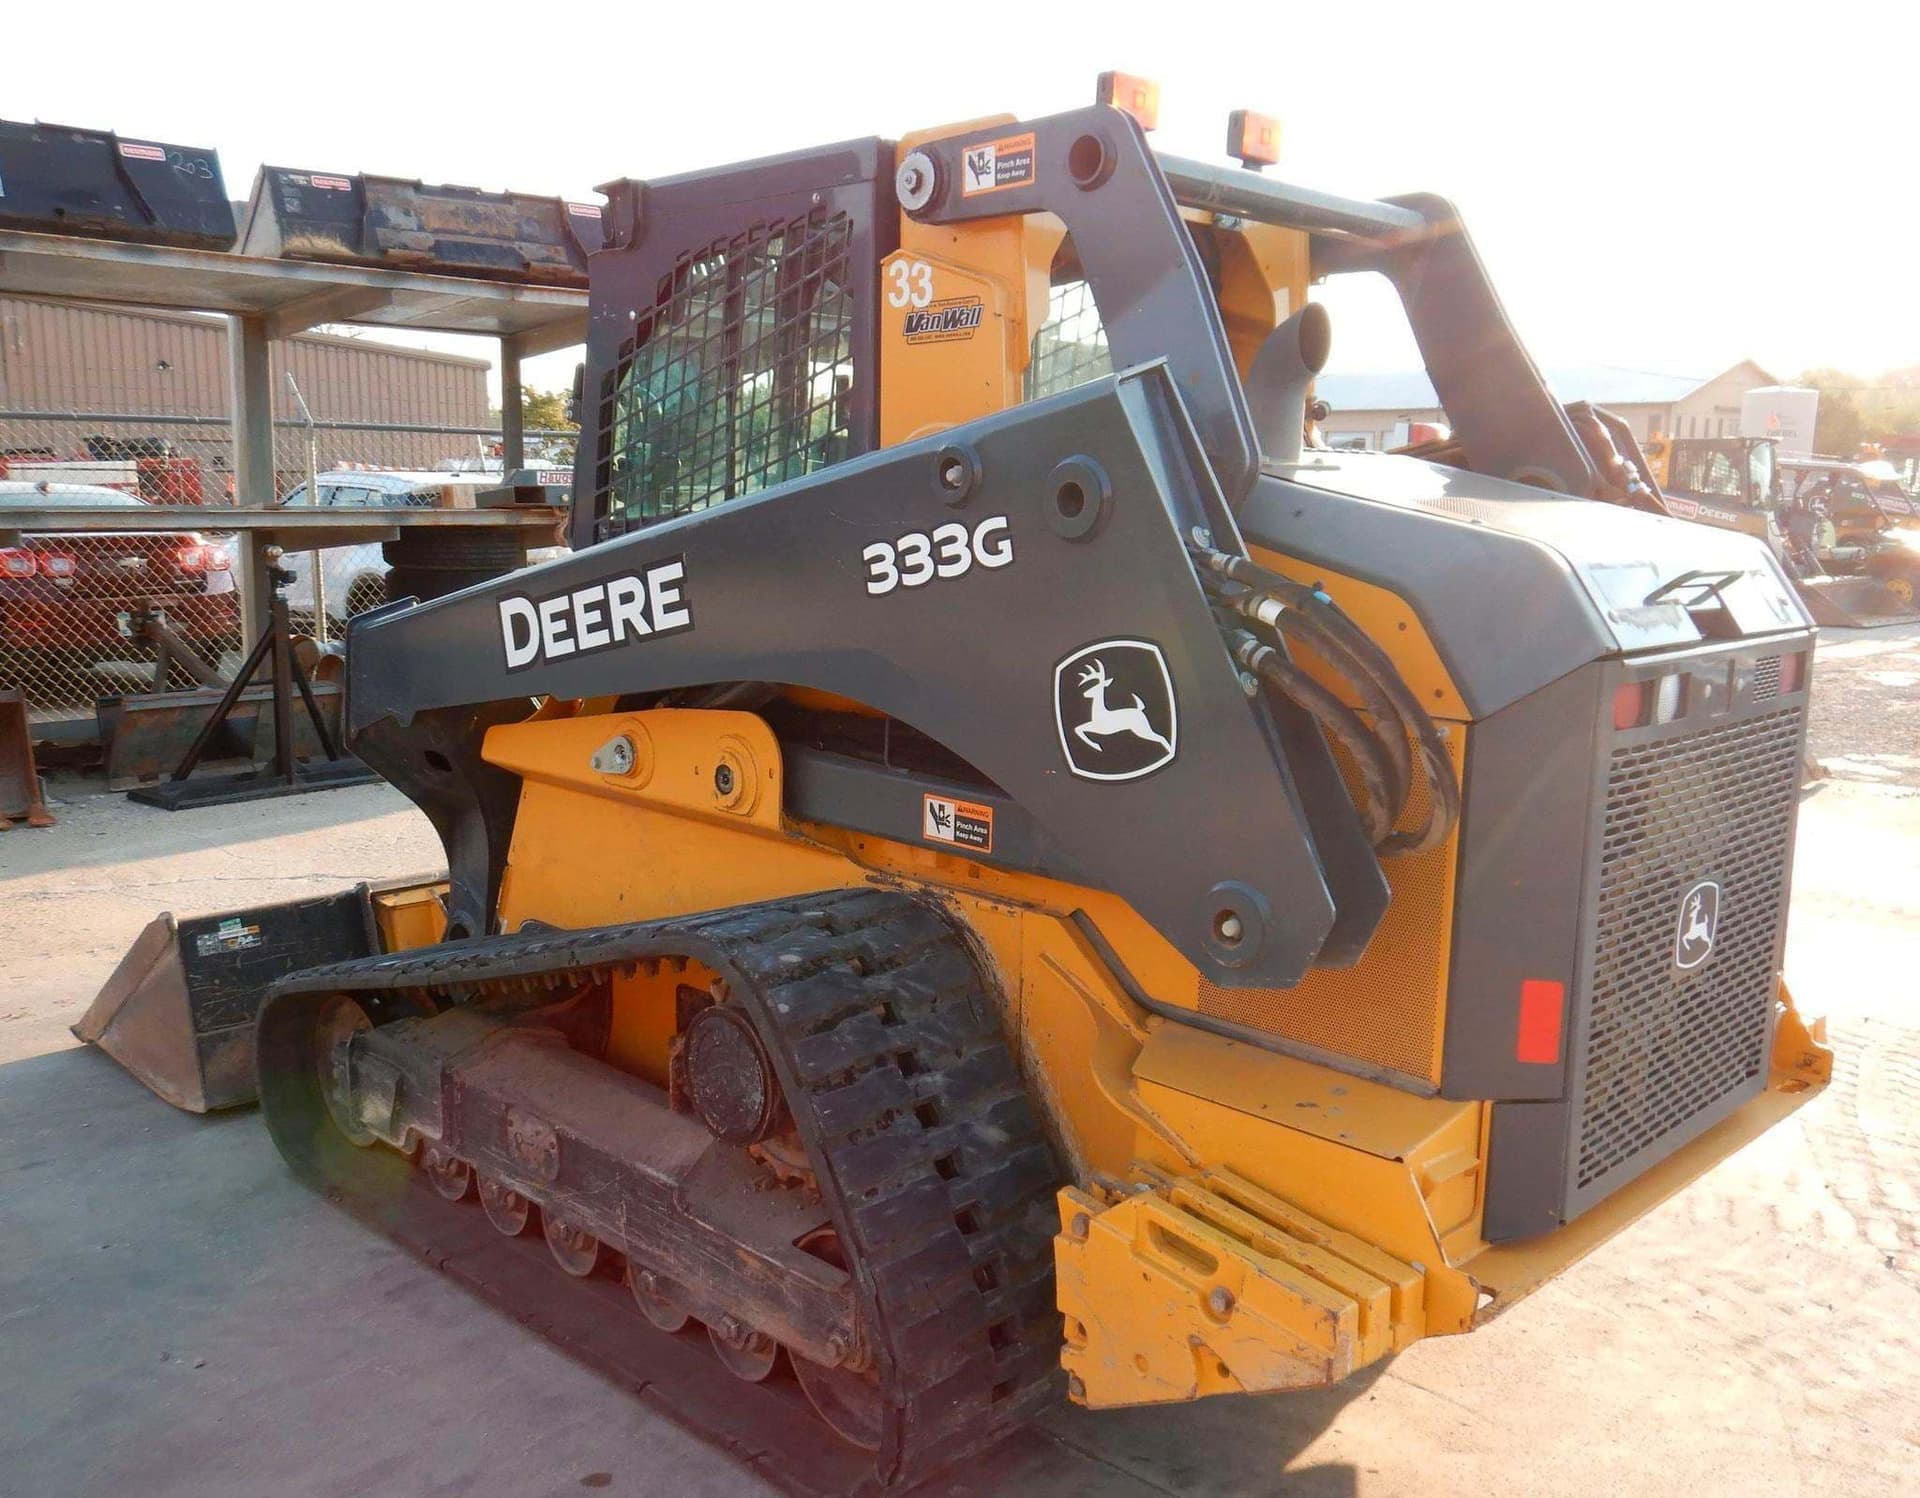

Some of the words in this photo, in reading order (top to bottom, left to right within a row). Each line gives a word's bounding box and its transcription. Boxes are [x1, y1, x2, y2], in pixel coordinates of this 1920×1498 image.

[997, 160, 1015, 170] Pinch
[1016, 157, 1030, 166] Area
[888, 259, 933, 308] 33
[1699, 505, 1737, 522] DEERE
[863, 516, 1013, 594] 333G
[499, 561, 690, 668] DEERE
[956, 821, 973, 832] Pinch
[973, 825, 988, 834] Area
[956, 831, 969, 840] Keep
[969, 834, 983, 843] Away
